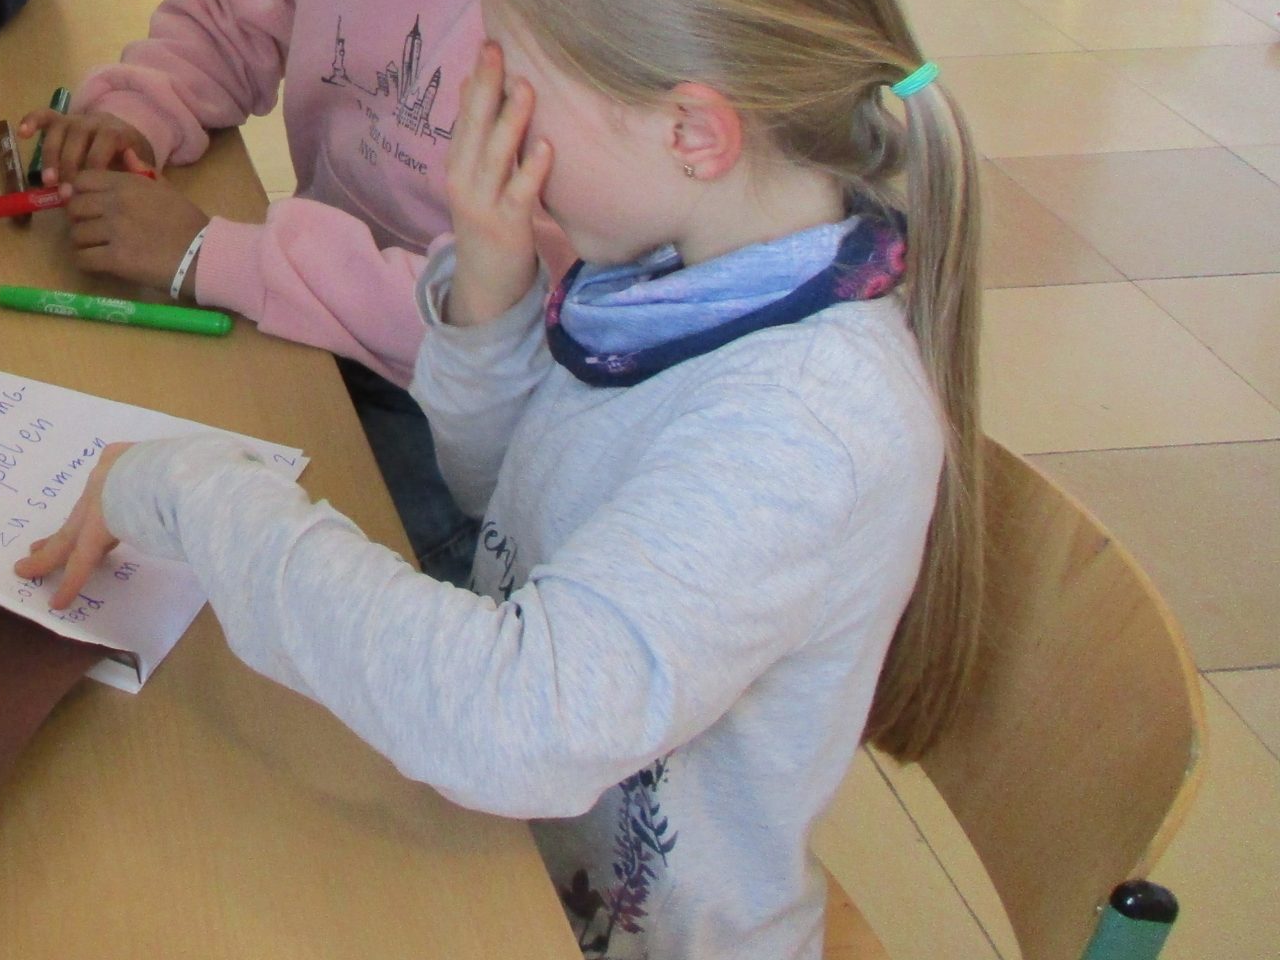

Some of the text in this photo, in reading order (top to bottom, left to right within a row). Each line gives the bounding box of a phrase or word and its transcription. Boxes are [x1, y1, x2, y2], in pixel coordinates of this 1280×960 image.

[394, 142, 428, 175] leave
[273, 453, 297, 467] 2
[114, 560, 141, 582] an
